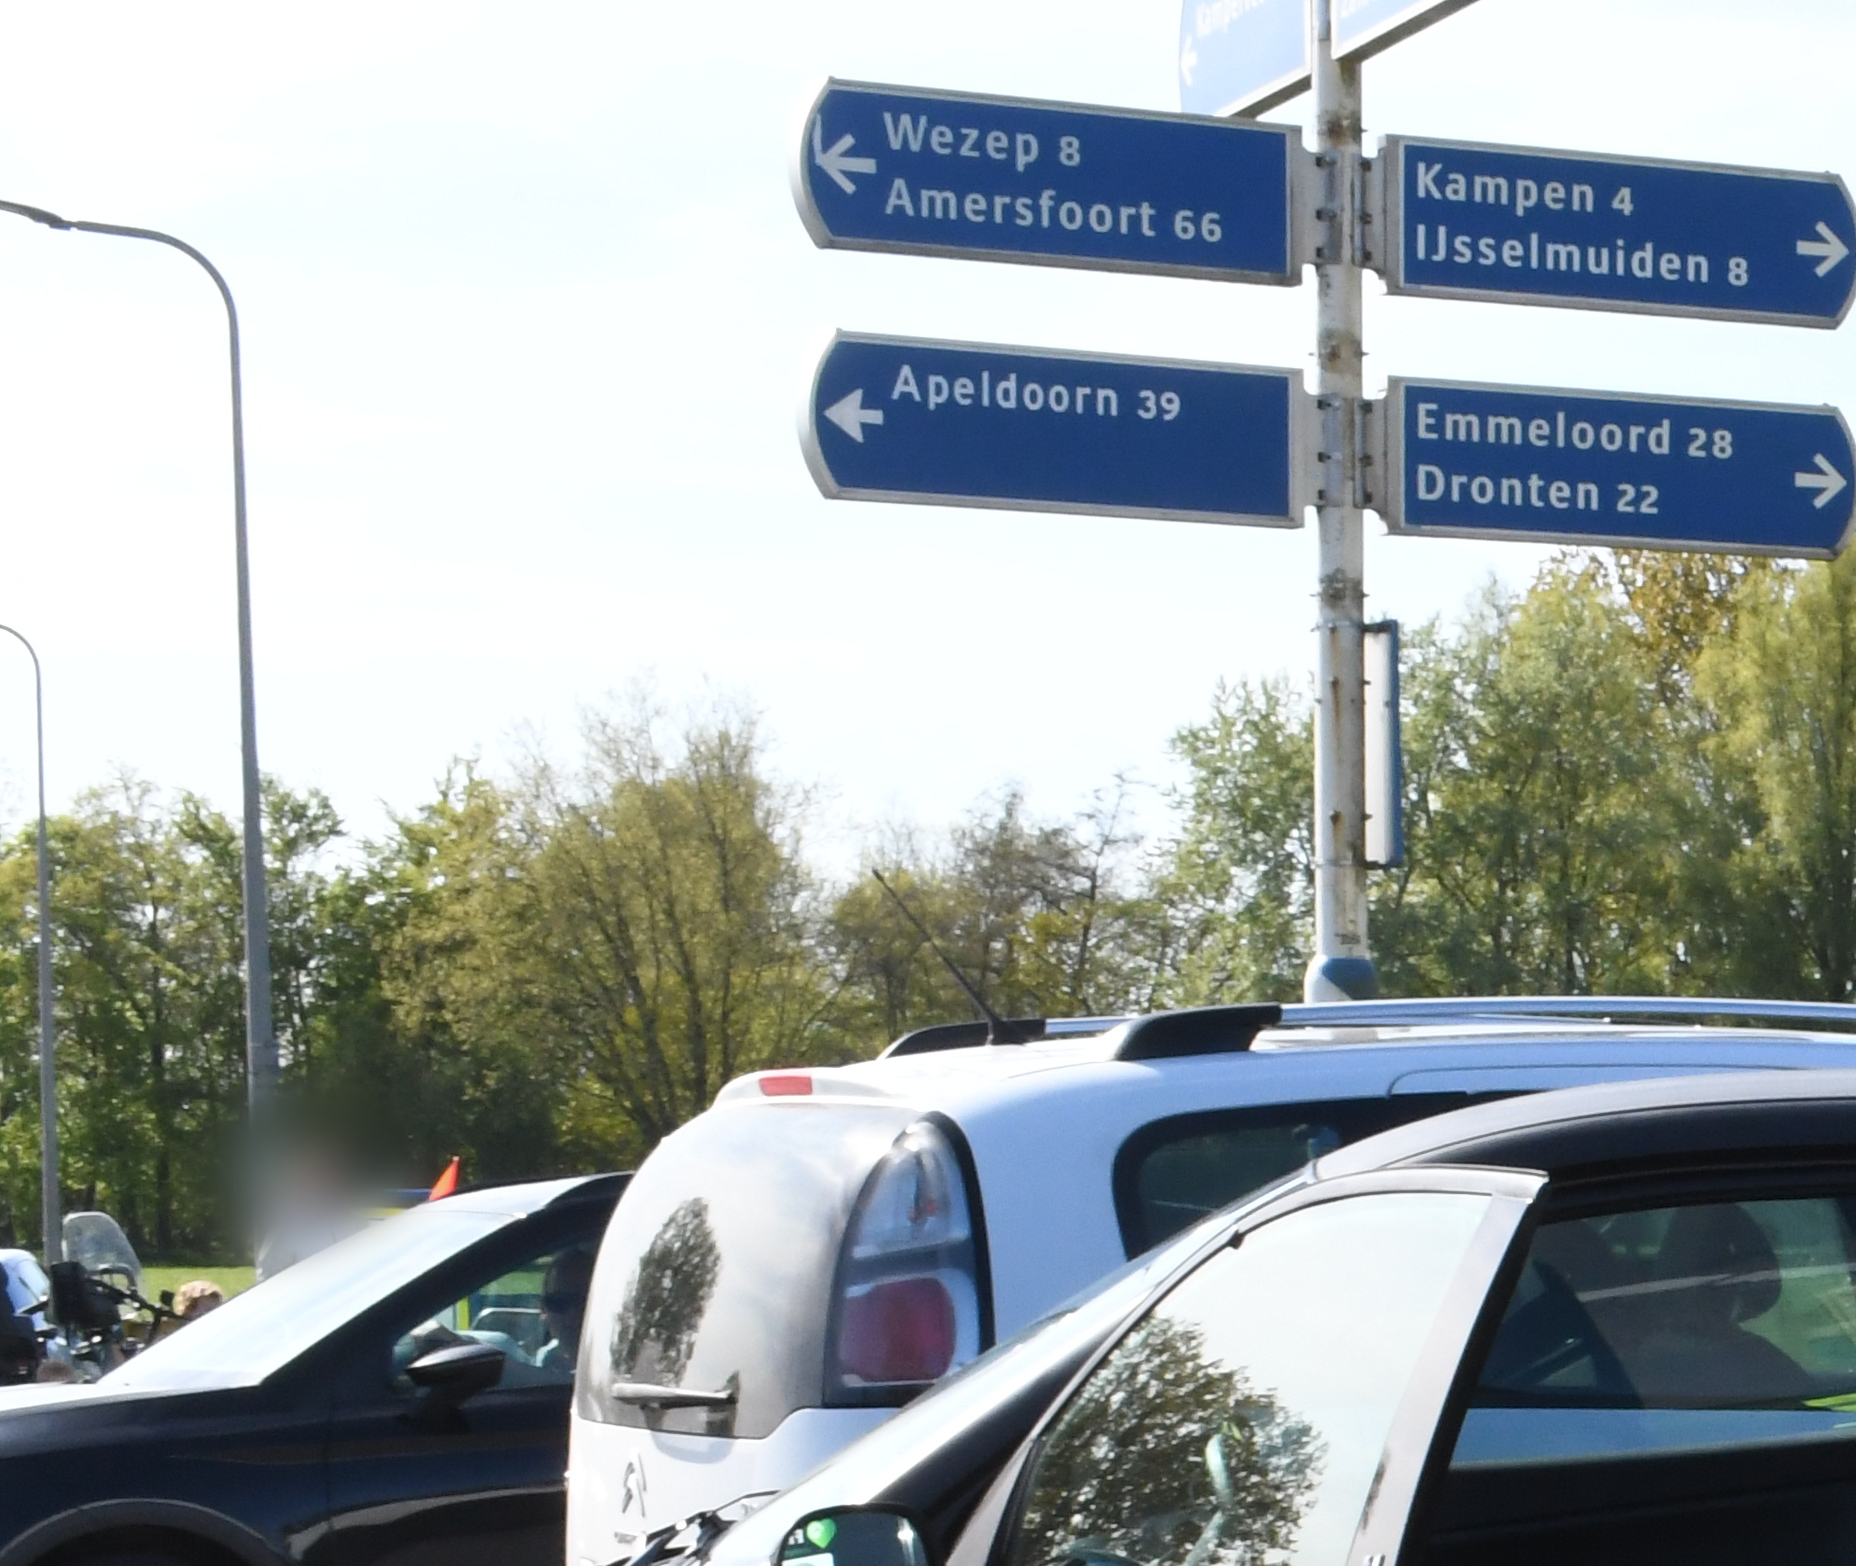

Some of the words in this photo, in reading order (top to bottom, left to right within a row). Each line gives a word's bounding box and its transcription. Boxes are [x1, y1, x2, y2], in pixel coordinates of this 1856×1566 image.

[883, 111, 1039, 173] Wezep
[1059, 135, 1081, 167] 8
[884, 177, 1156, 237] Amersfoort
[1173, 209, 1223, 243] 66
[1416, 161, 1594, 217] Kampen
[1611, 187, 1634, 216] 4
[1416, 223, 1709, 284] IJsselmuiden
[1727, 256, 1749, 287] 8
[891, 363, 1118, 417] Apeldoorn
[1137, 390, 1181, 421] 39
[1416, 402, 1670, 455] Emmeloord
[1687, 428, 1734, 459] 28
[1416, 464, 1599, 511] Dronten
[1616, 484, 1660, 514] 22
